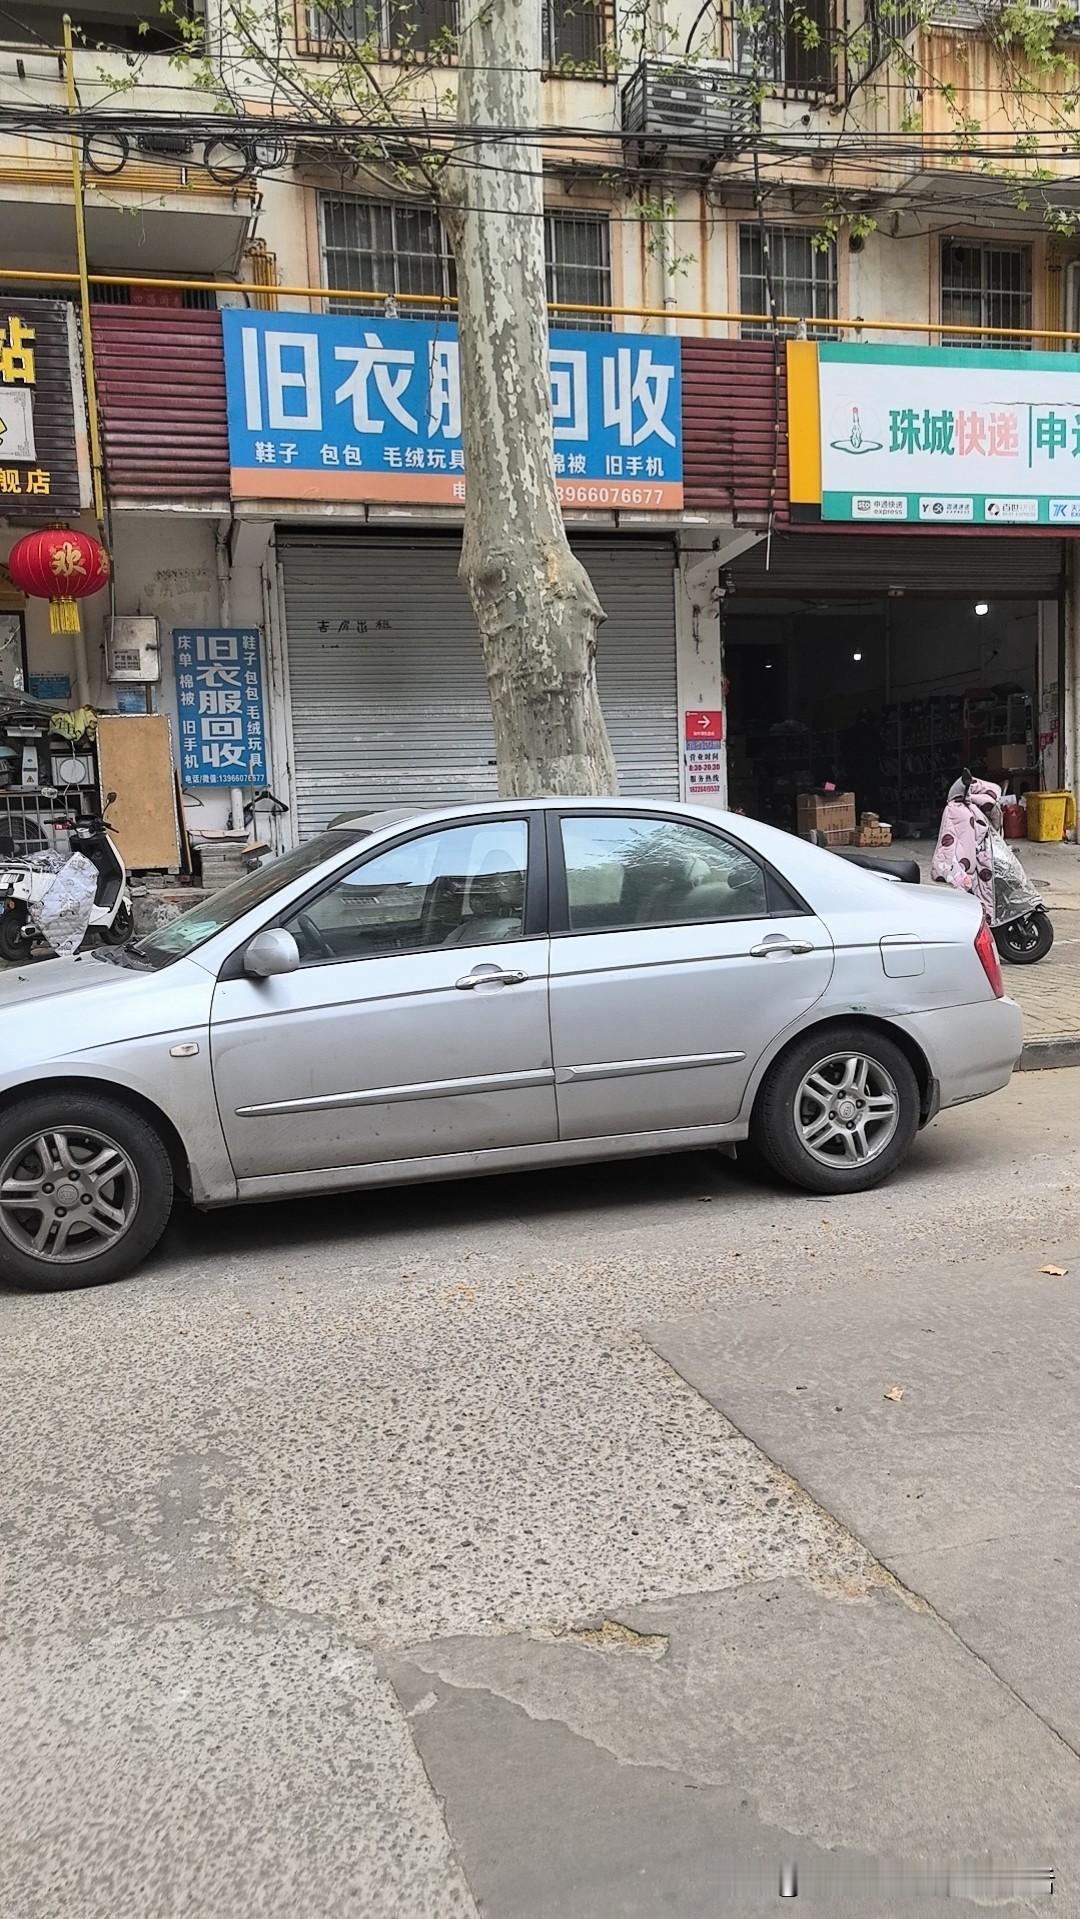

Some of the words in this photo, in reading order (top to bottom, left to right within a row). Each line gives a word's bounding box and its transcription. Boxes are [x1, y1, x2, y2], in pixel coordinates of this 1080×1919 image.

[889, 409, 1019, 456] 珠城快递
[1036, 411, 1080, 459] 申
[255, 441, 299, 464] 鞋子
[320, 443, 362, 466] 包包
[605, 454, 665, 477] 旧手机
[178, 635, 193, 668] 床单
[242, 635, 257, 666] 鞋子
[179, 674, 195, 706] 棉被
[196, 636, 247, 768] 旧衣服回收
[244, 670, 259, 701] 包包
[182, 720, 199, 769] 旧手机
[246, 705, 263, 768] 毛绒玩具
